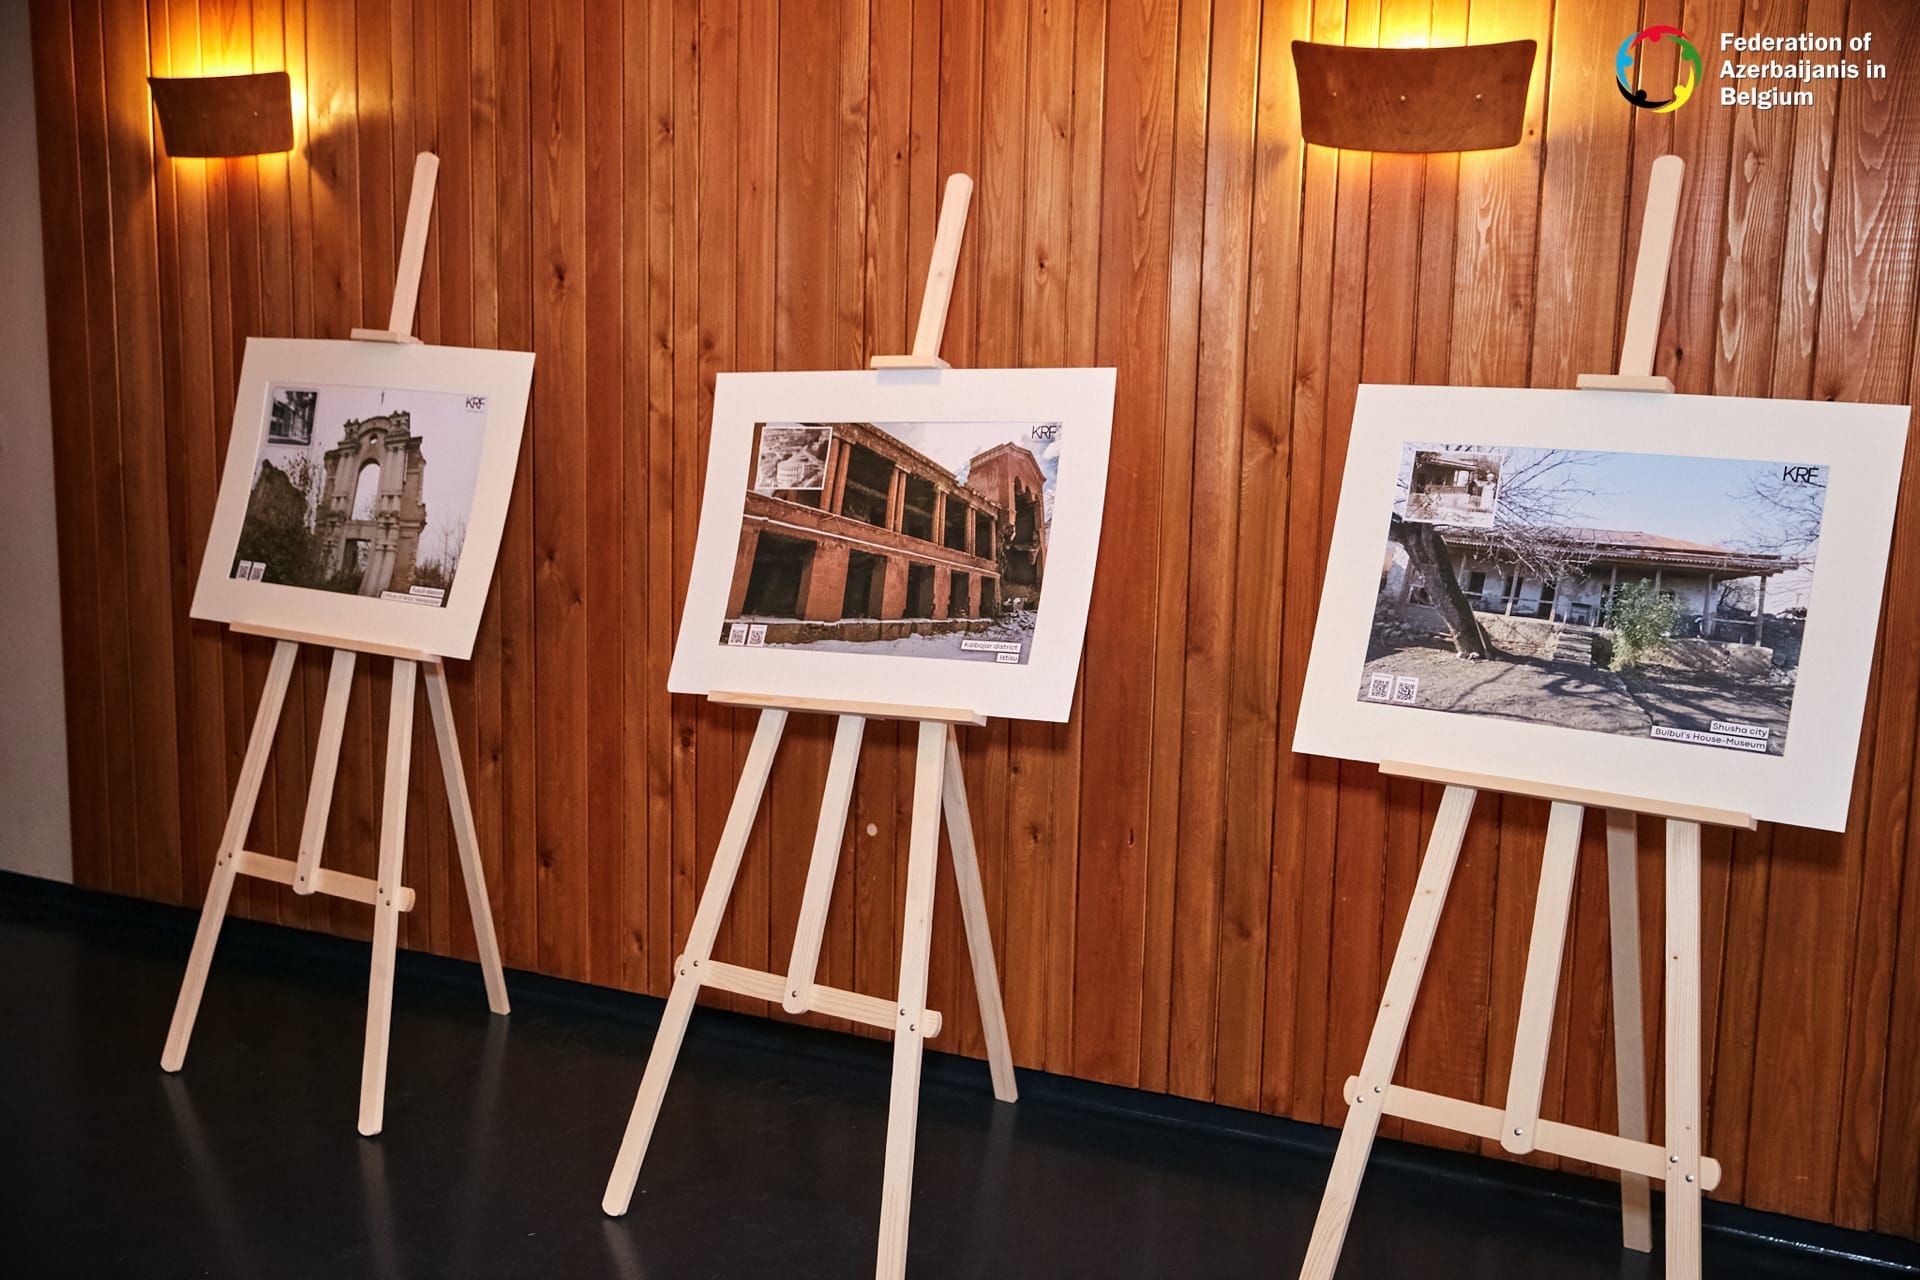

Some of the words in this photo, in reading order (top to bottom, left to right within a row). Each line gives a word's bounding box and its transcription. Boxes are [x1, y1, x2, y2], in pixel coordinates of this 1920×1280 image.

[465, 396, 486, 410] KRF
[1031, 425, 1057, 439] KRF
[1782, 465, 1820, 484] KRF
[993, 643, 1018, 651] district
[1712, 722, 1747, 734] Shusha
[1749, 727, 1768, 737] city
[1655, 728, 1691, 740] Bulbul's
[1693, 733, 1766, 750] House-Museum
